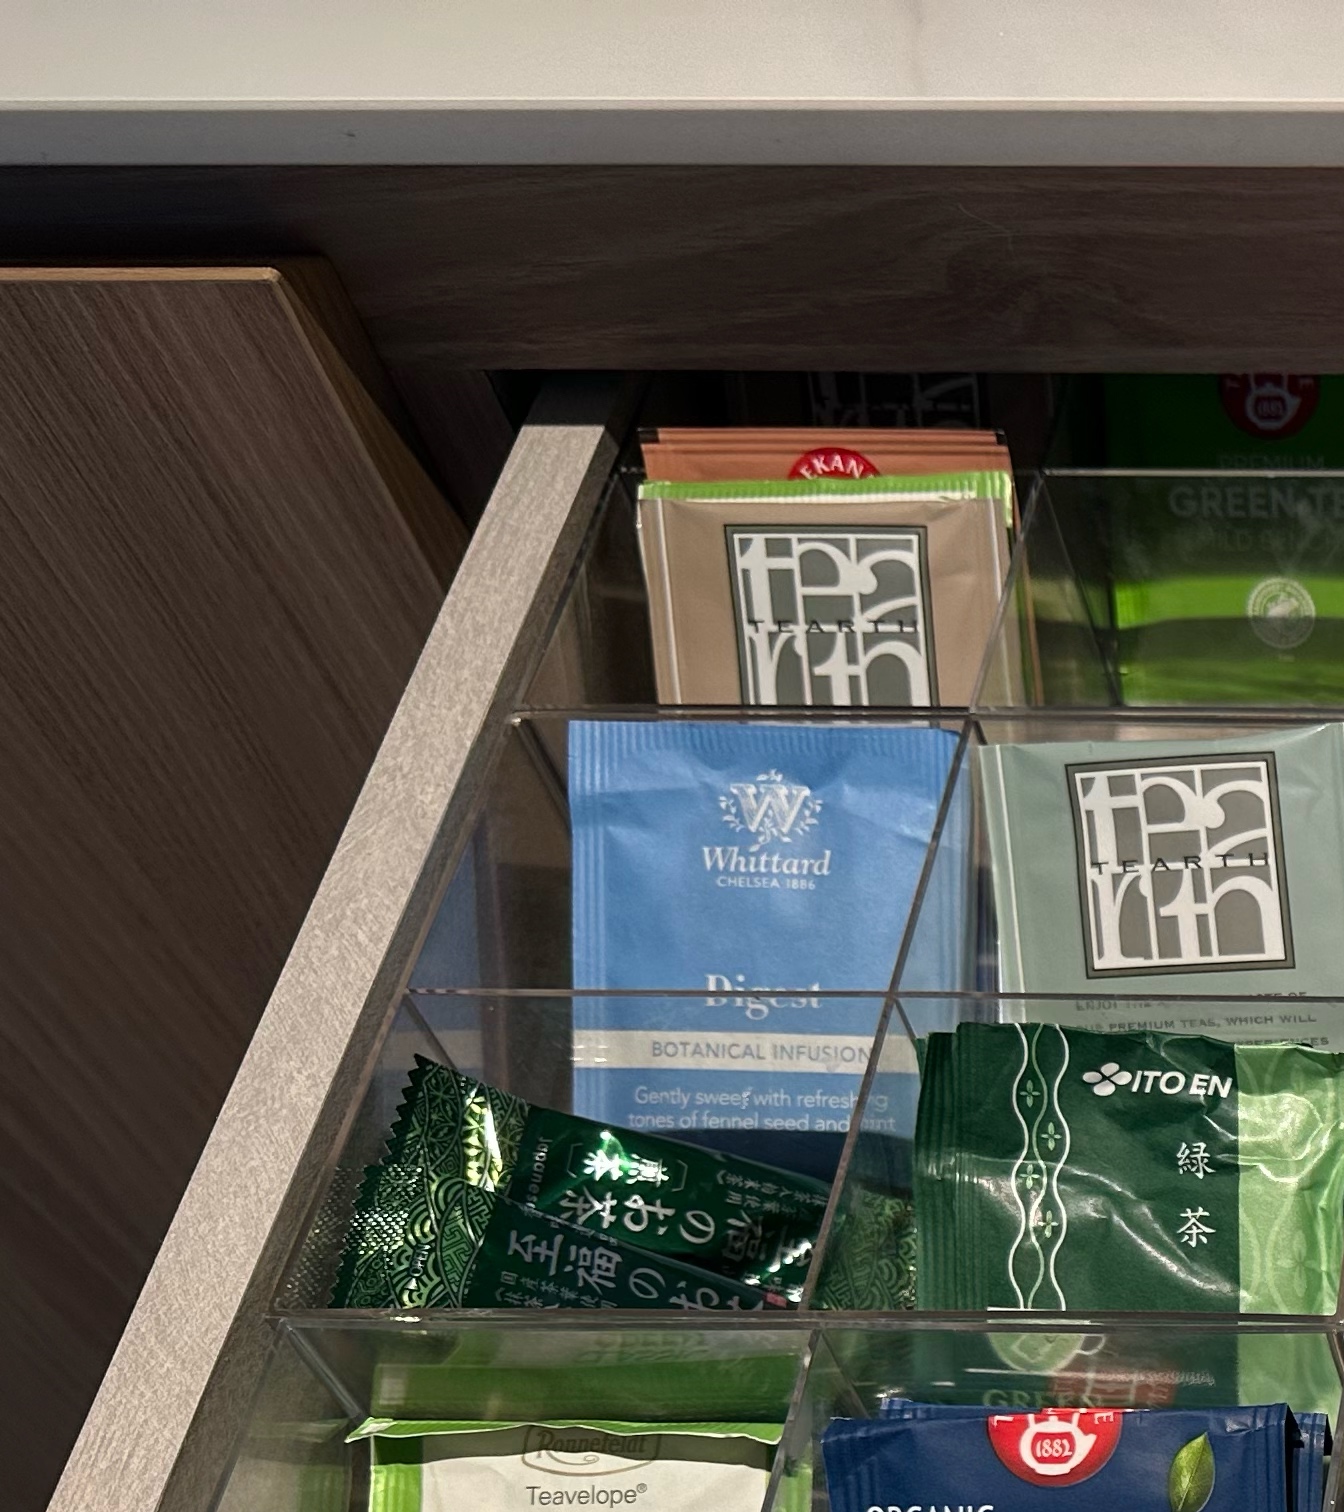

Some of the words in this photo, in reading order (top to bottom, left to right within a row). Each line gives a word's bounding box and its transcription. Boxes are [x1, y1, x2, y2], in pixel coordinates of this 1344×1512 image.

[702, 846, 832, 877] Whittard
[1091, 851, 1270, 875] TEARTH
[717, 876, 780, 889] CHELSEA
[705, 974, 822, 1021] Digest
[652, 1040, 767, 1060] BOTANICAL
[773, 1042, 871, 1063] INFUSION
[1131, 1070, 1186, 1096] ITO
[1189, 1075, 1234, 1098] EN
[635, 1086, 691, 1108] Gently
[753, 1089, 790, 1107] with
[628, 1115, 669, 1129] tones
[677, 1112, 698, 1130] of
[702, 1111, 760, 1130] fennel
[764, 1113, 809, 1131] seed
[814, 1113, 850, 1132] and
[1176, 1141, 1217, 1248] 緑茶
[1035, 1438, 1073, 1459] 1882
